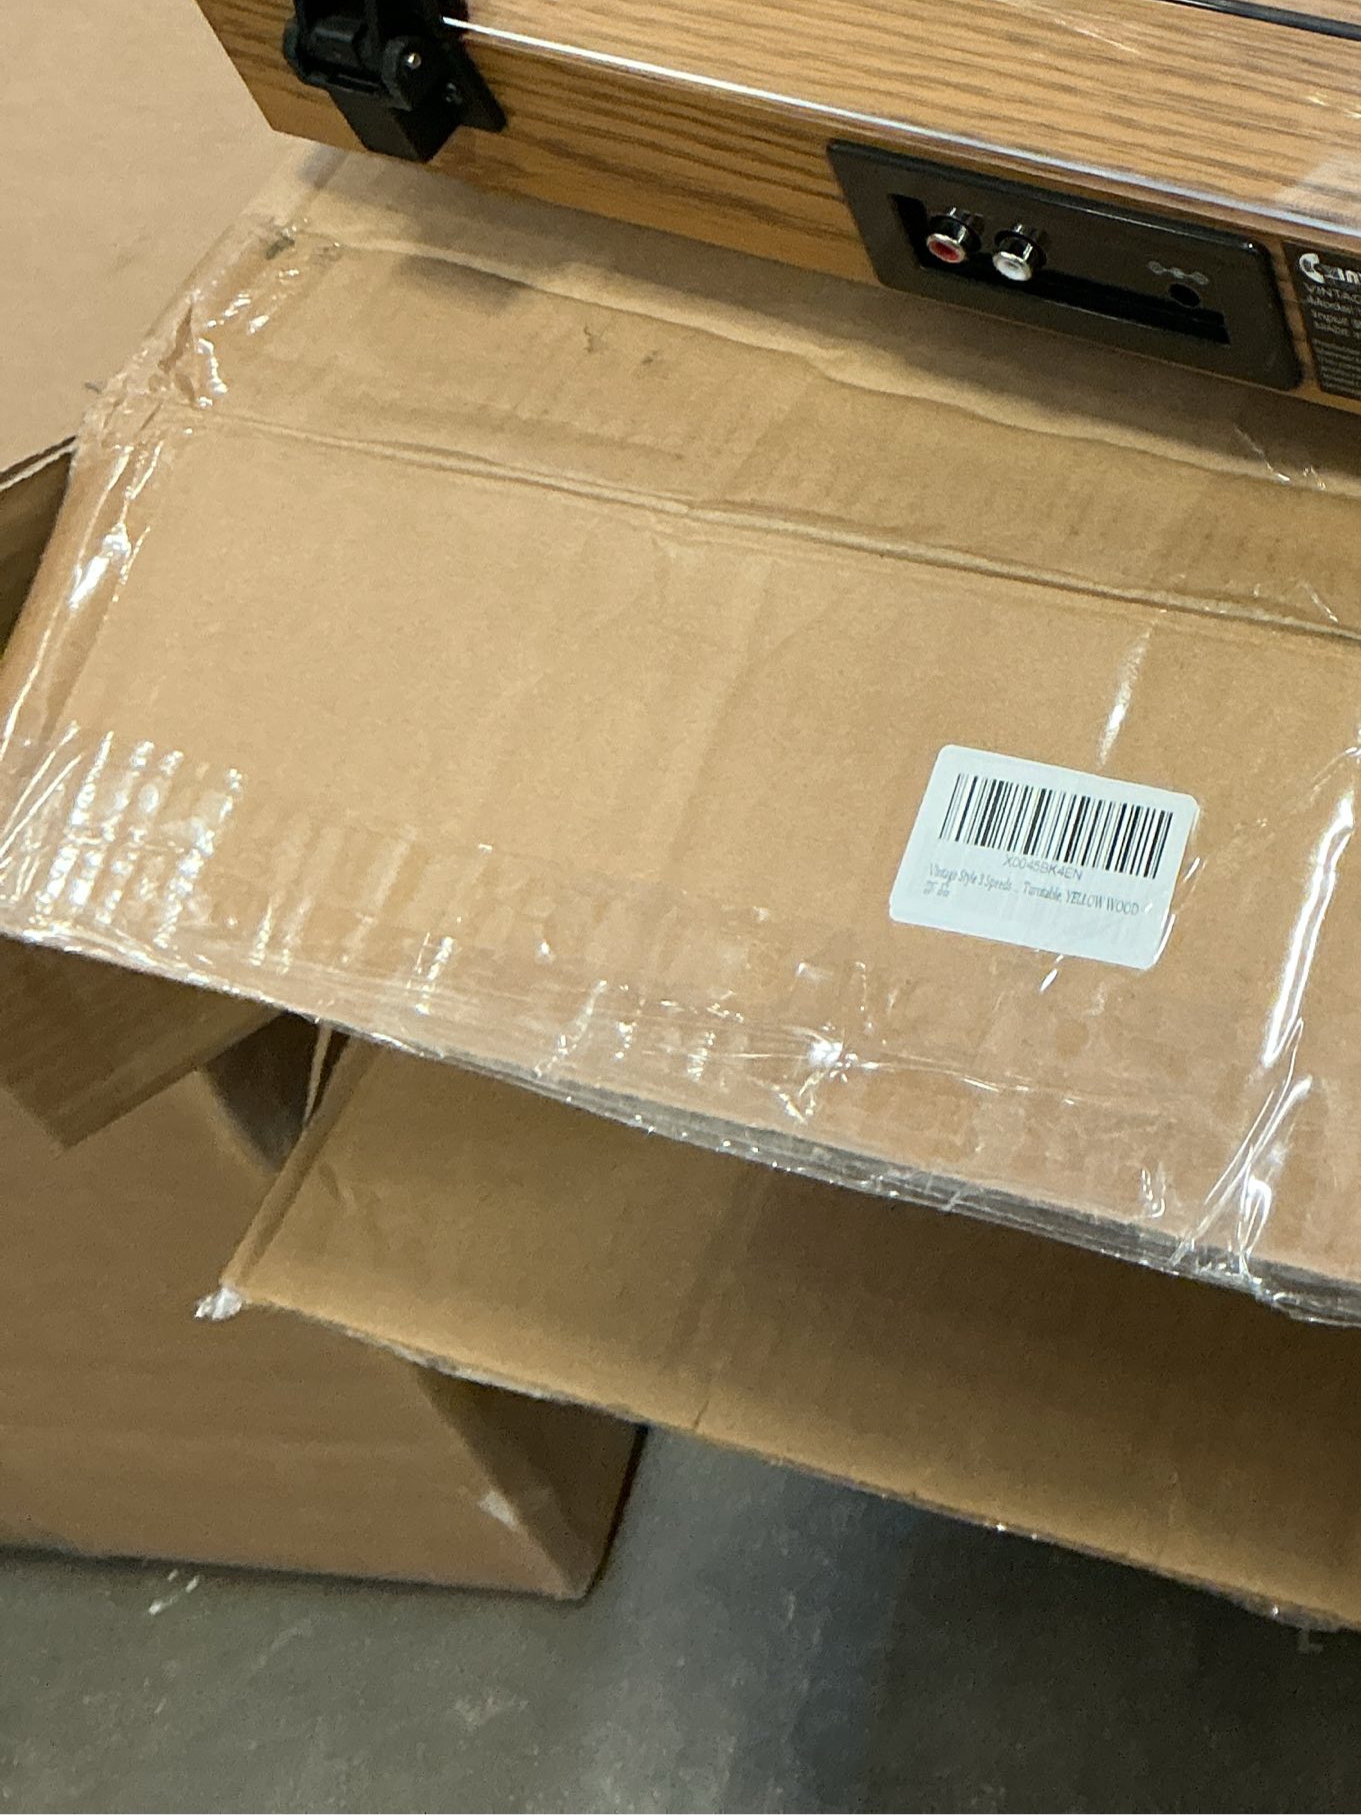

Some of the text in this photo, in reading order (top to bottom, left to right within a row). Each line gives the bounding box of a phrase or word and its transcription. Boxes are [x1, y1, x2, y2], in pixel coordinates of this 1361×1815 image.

[1003, 853, 1083, 881] X0045BK4EN
[960, 869, 977, 887] Style
[1066, 888, 1103, 911] YELLOW
[1105, 895, 1140, 916] WOOD
